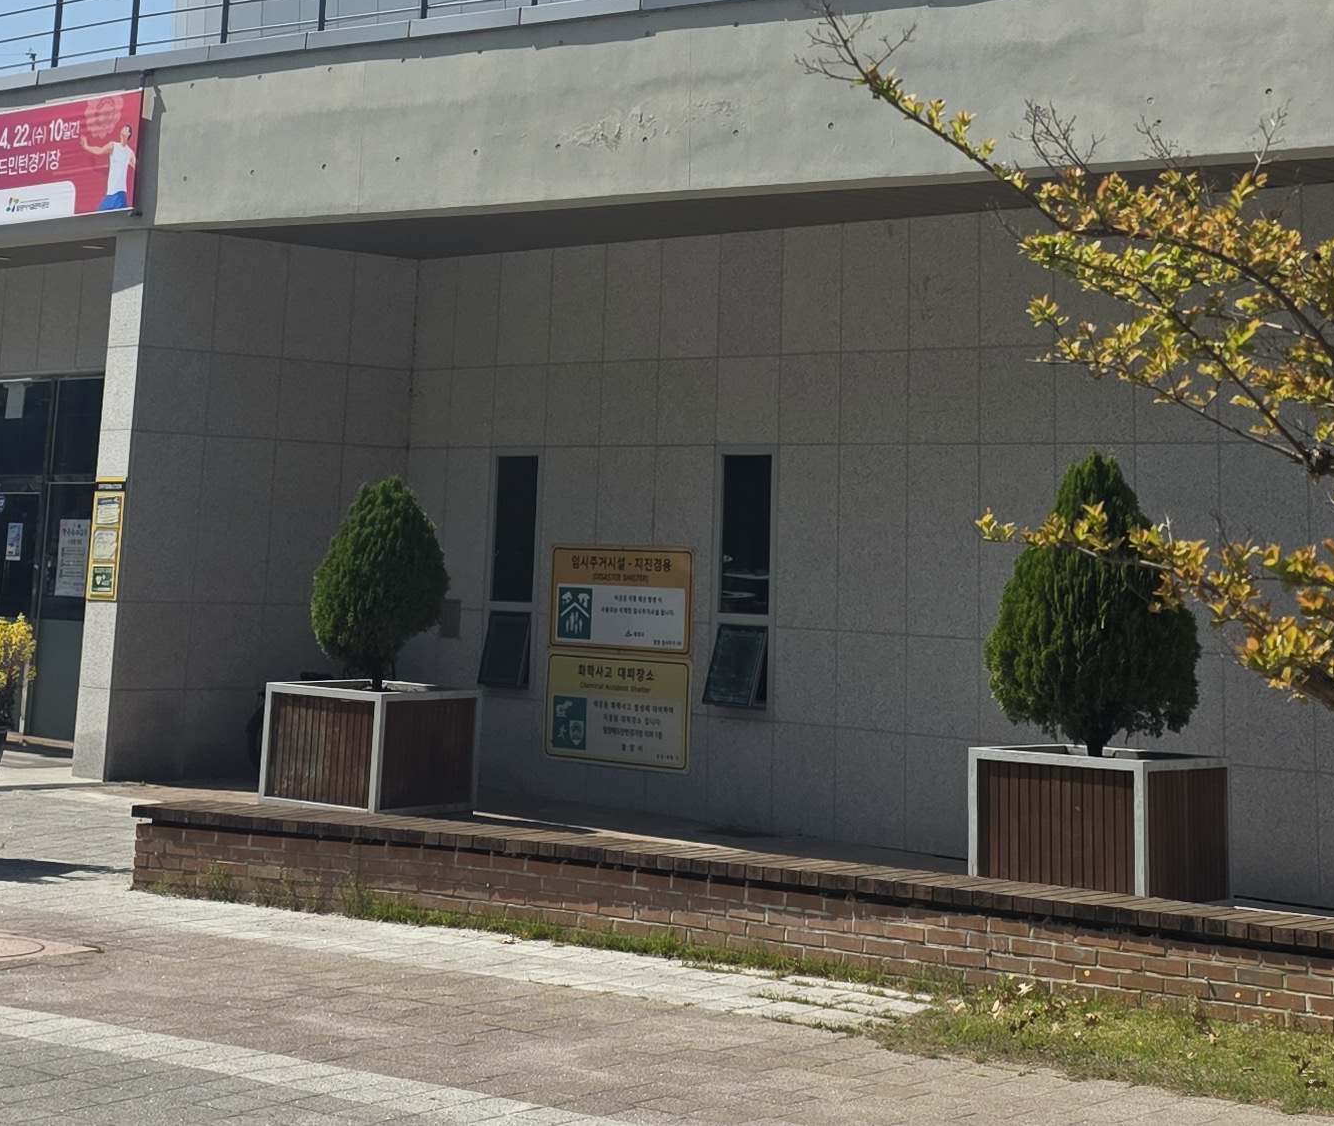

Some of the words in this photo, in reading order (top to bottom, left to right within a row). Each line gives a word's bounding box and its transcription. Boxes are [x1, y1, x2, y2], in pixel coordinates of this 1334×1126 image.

[571, 555, 626, 571] 임시주거시설
[634, 557, 672, 573] 지진겸용
[578, 665, 612, 679] 화학사고
[617, 667, 655, 683] 대피장소
[579, 681, 604, 691] Chemical
[605, 683, 629, 693] Accident
[630, 685, 651, 694] Shelter
